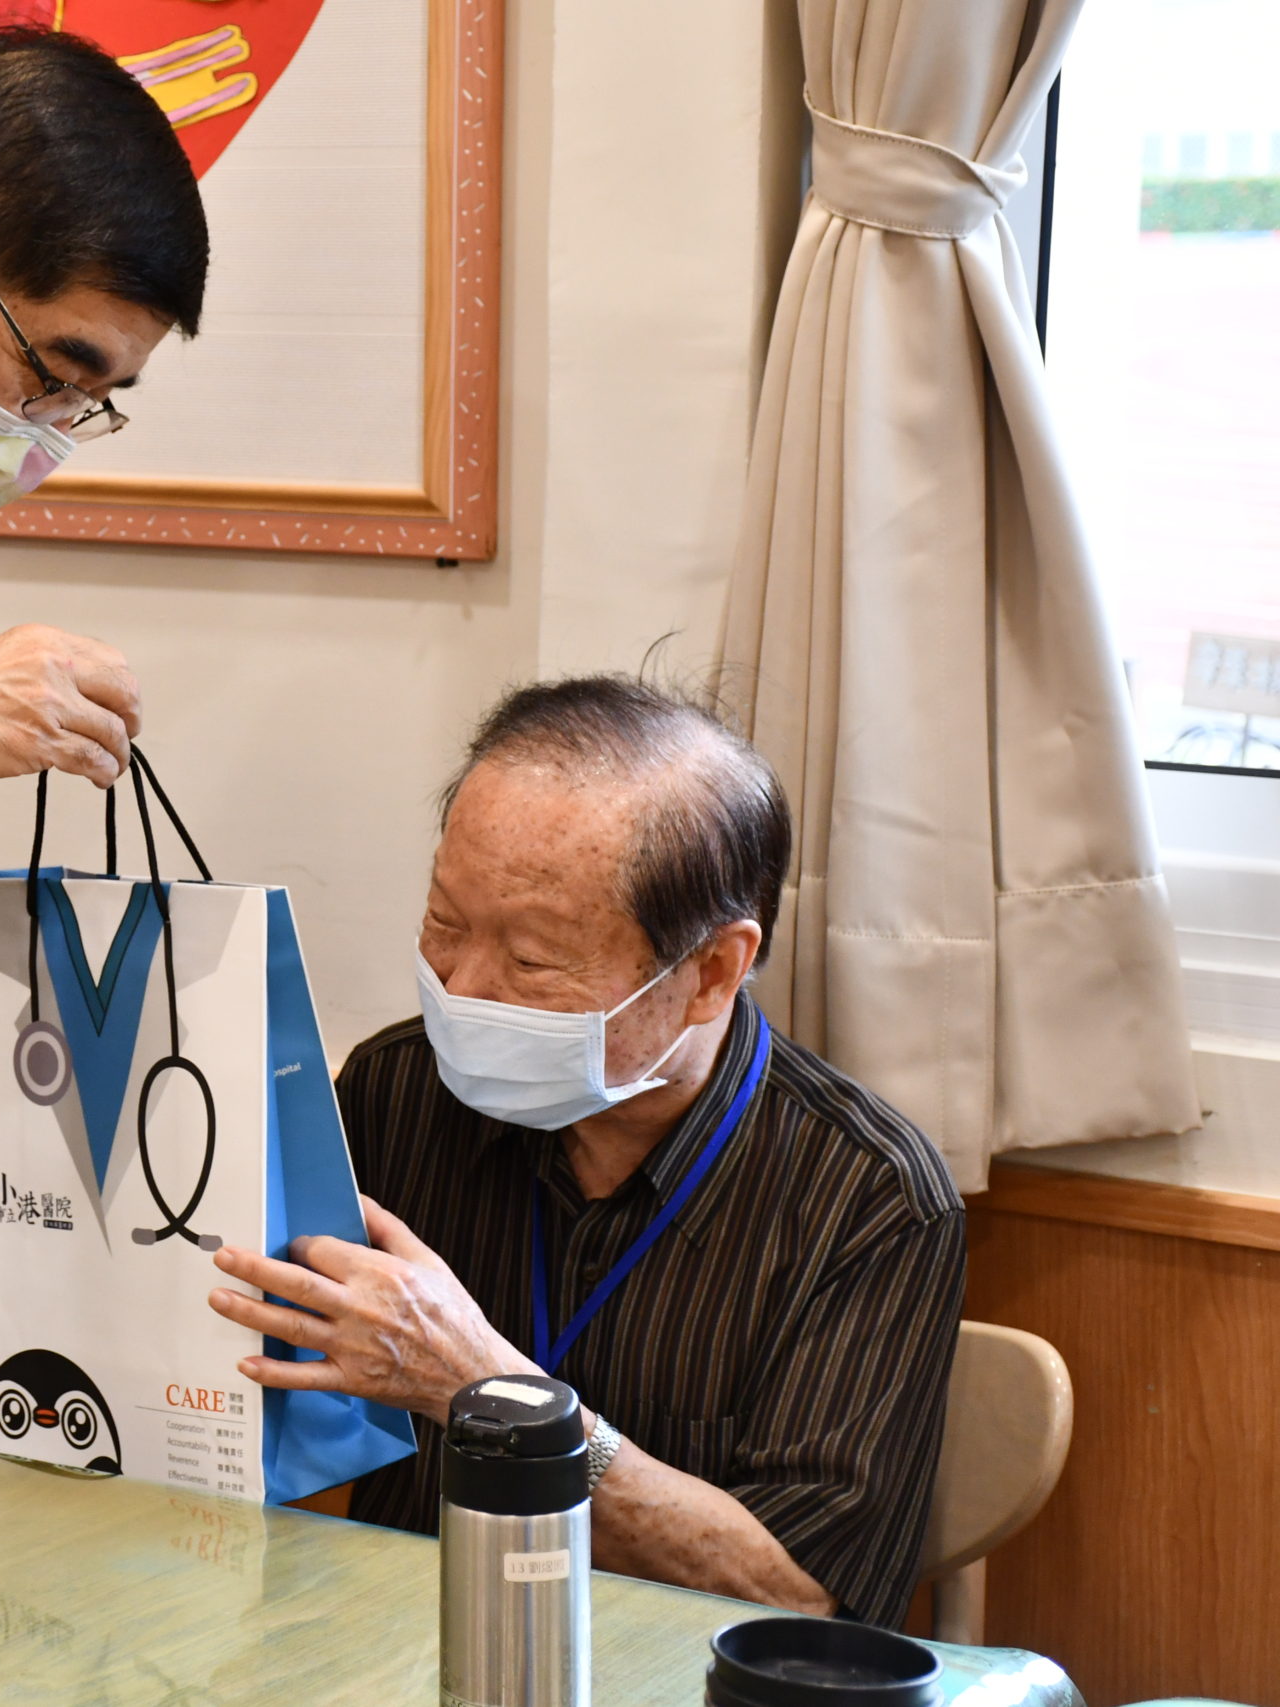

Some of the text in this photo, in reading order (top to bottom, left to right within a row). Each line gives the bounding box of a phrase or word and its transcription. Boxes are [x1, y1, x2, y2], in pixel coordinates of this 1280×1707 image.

[166, 1383, 226, 1413] CARE
[166, 1420, 206, 1434] Cooperation
[167, 1438, 212, 1455] Accountability
[168, 1453, 200, 1467] Reverence
[168, 1470, 209, 1485] Effectiveness
